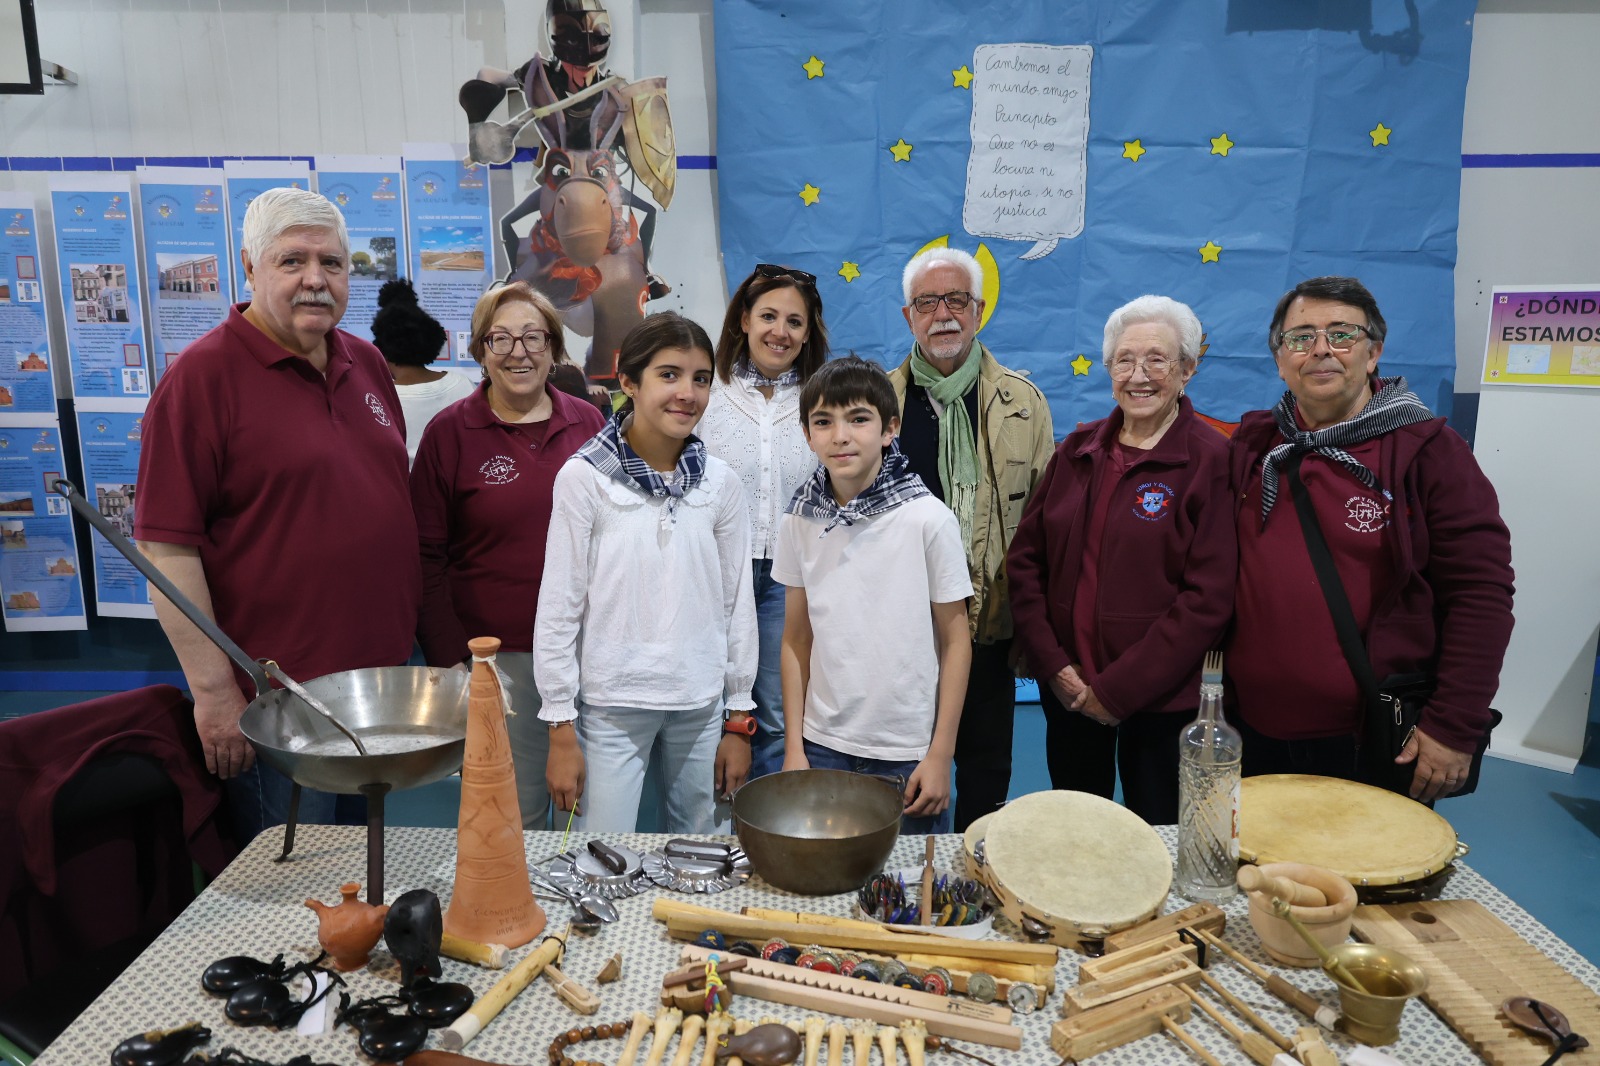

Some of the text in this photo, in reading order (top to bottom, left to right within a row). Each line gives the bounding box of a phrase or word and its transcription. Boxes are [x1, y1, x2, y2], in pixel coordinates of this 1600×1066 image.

[1057, 59, 1071, 76] el
[1043, 86, 1079, 103] amigo
[995, 104, 1057, 130] Principito
[988, 133, 1055, 152] Que no es
[992, 156, 1055, 177] locura ni
[1041, 186, 1055, 198] si
[1057, 187, 1075, 199] no
[993, 201, 1048, 224] justicia
[1515, 295, 1600, 318] ¿DÓND
